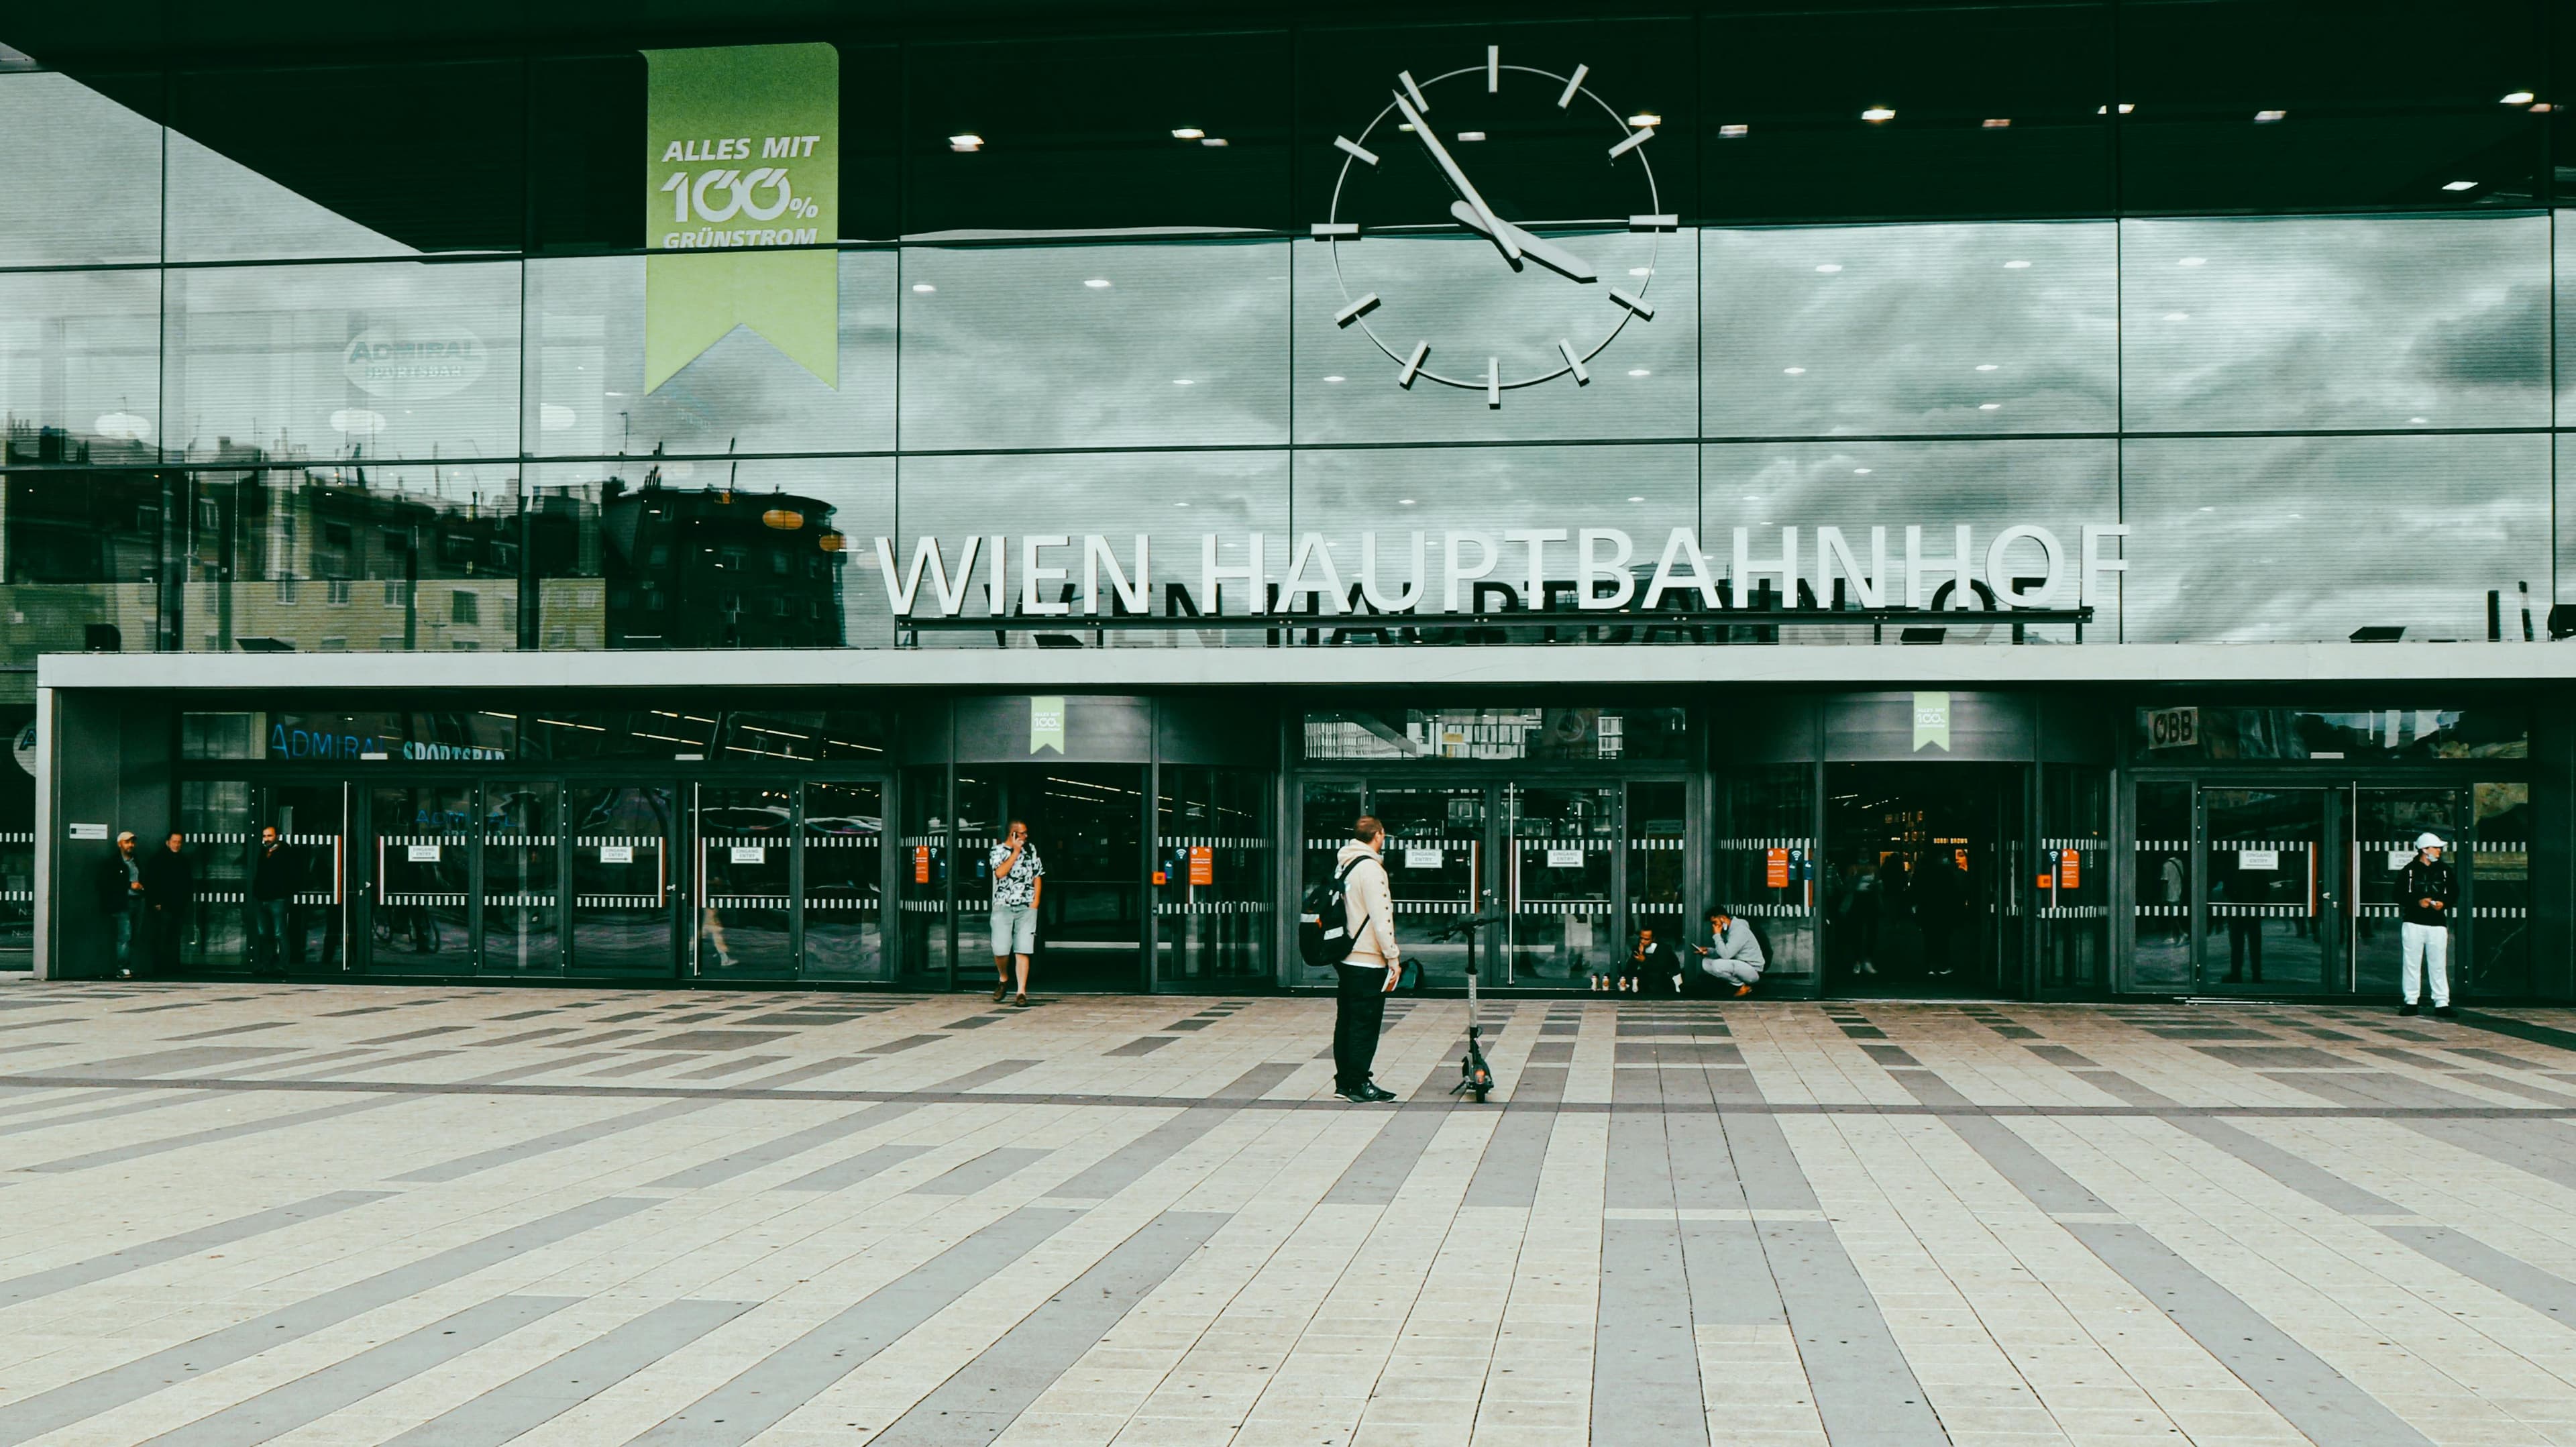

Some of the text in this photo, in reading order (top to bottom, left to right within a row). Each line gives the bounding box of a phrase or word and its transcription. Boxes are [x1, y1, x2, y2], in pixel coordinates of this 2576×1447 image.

[661, 136, 820, 162] ALLES MIT
[660, 168, 818, 223] 100%
[663, 227, 818, 249] GRÜNSTROM
[348, 340, 484, 364] ADMIRAL
[874, 534, 1150, 615] WIEN
[1201, 525, 2131, 613] HAUPTBAHNHOF
